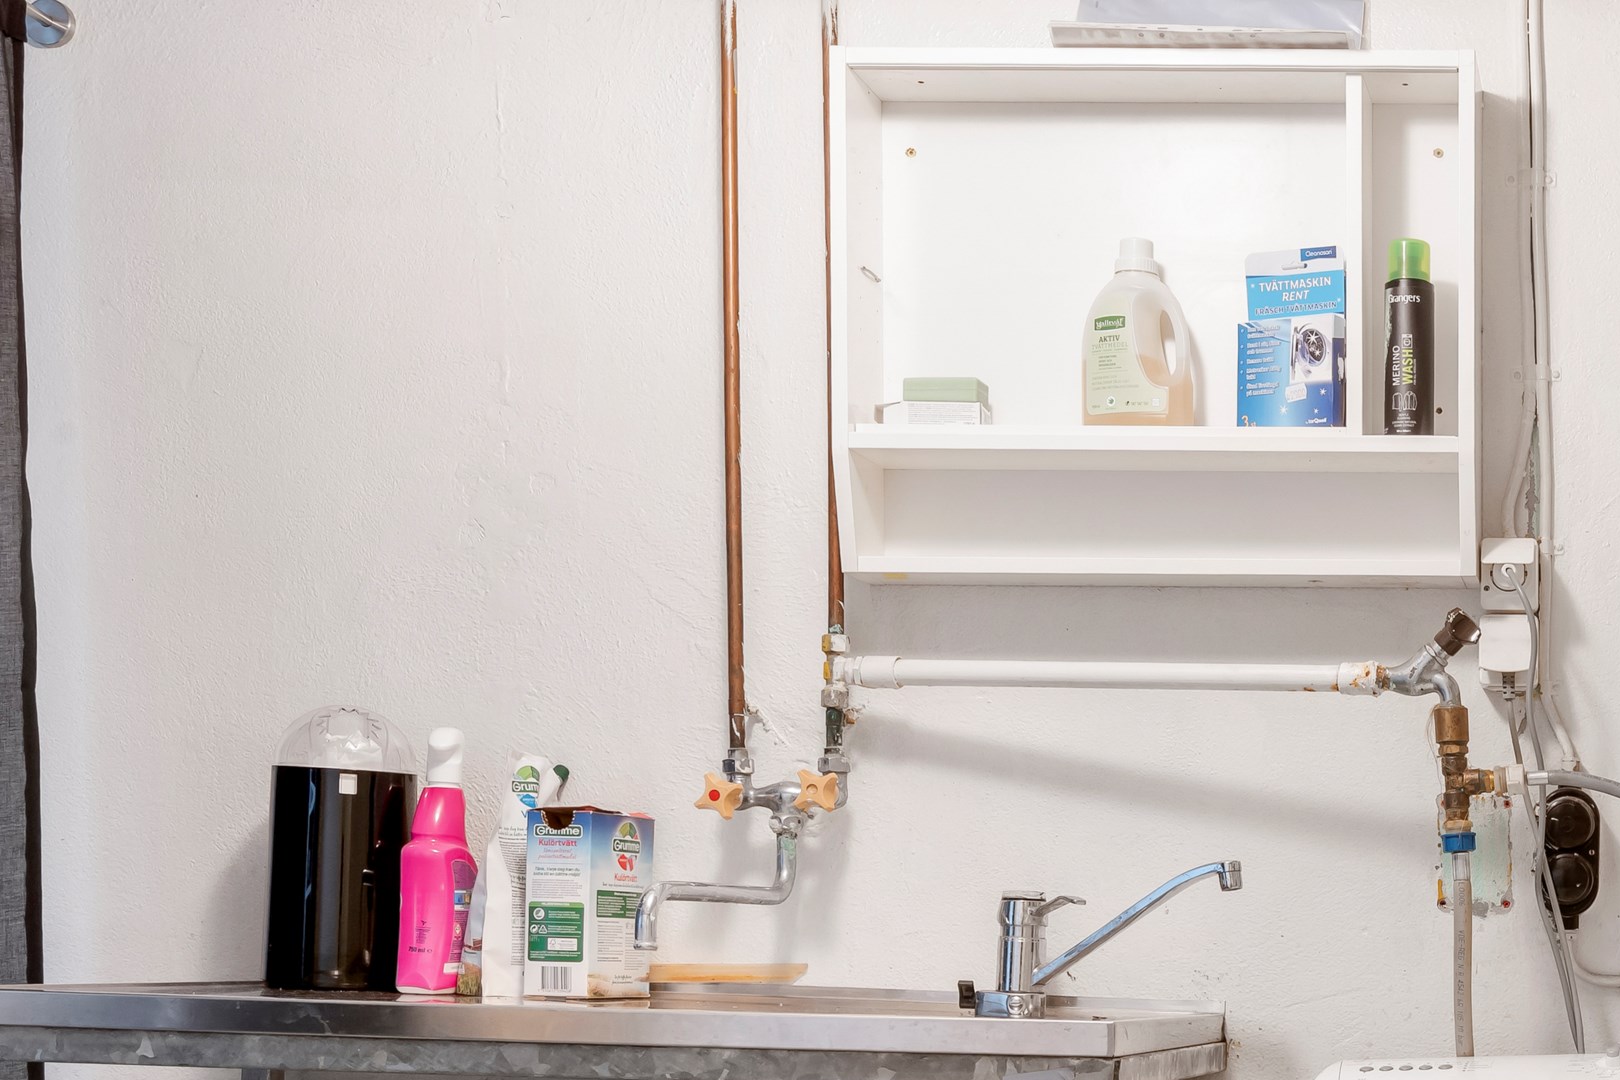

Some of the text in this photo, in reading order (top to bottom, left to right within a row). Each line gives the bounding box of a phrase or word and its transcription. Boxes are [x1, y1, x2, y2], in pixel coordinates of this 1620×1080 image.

[1258, 276, 1332, 293] TVÄTTMASKIN
[1282, 290, 1310, 302] RENT
[1388, 294, 1421, 304] Grangers
[1255, 301, 1338, 316] FRÄSCH TVÄTTMASKIN
[1098, 334, 1121, 343] AKTIV
[1392, 345, 1401, 386] MERINO
[1402, 348, 1414, 385] WASH
[1241, 415, 1249, 427] 3
[538, 838, 578, 847] Kulörtvätt
